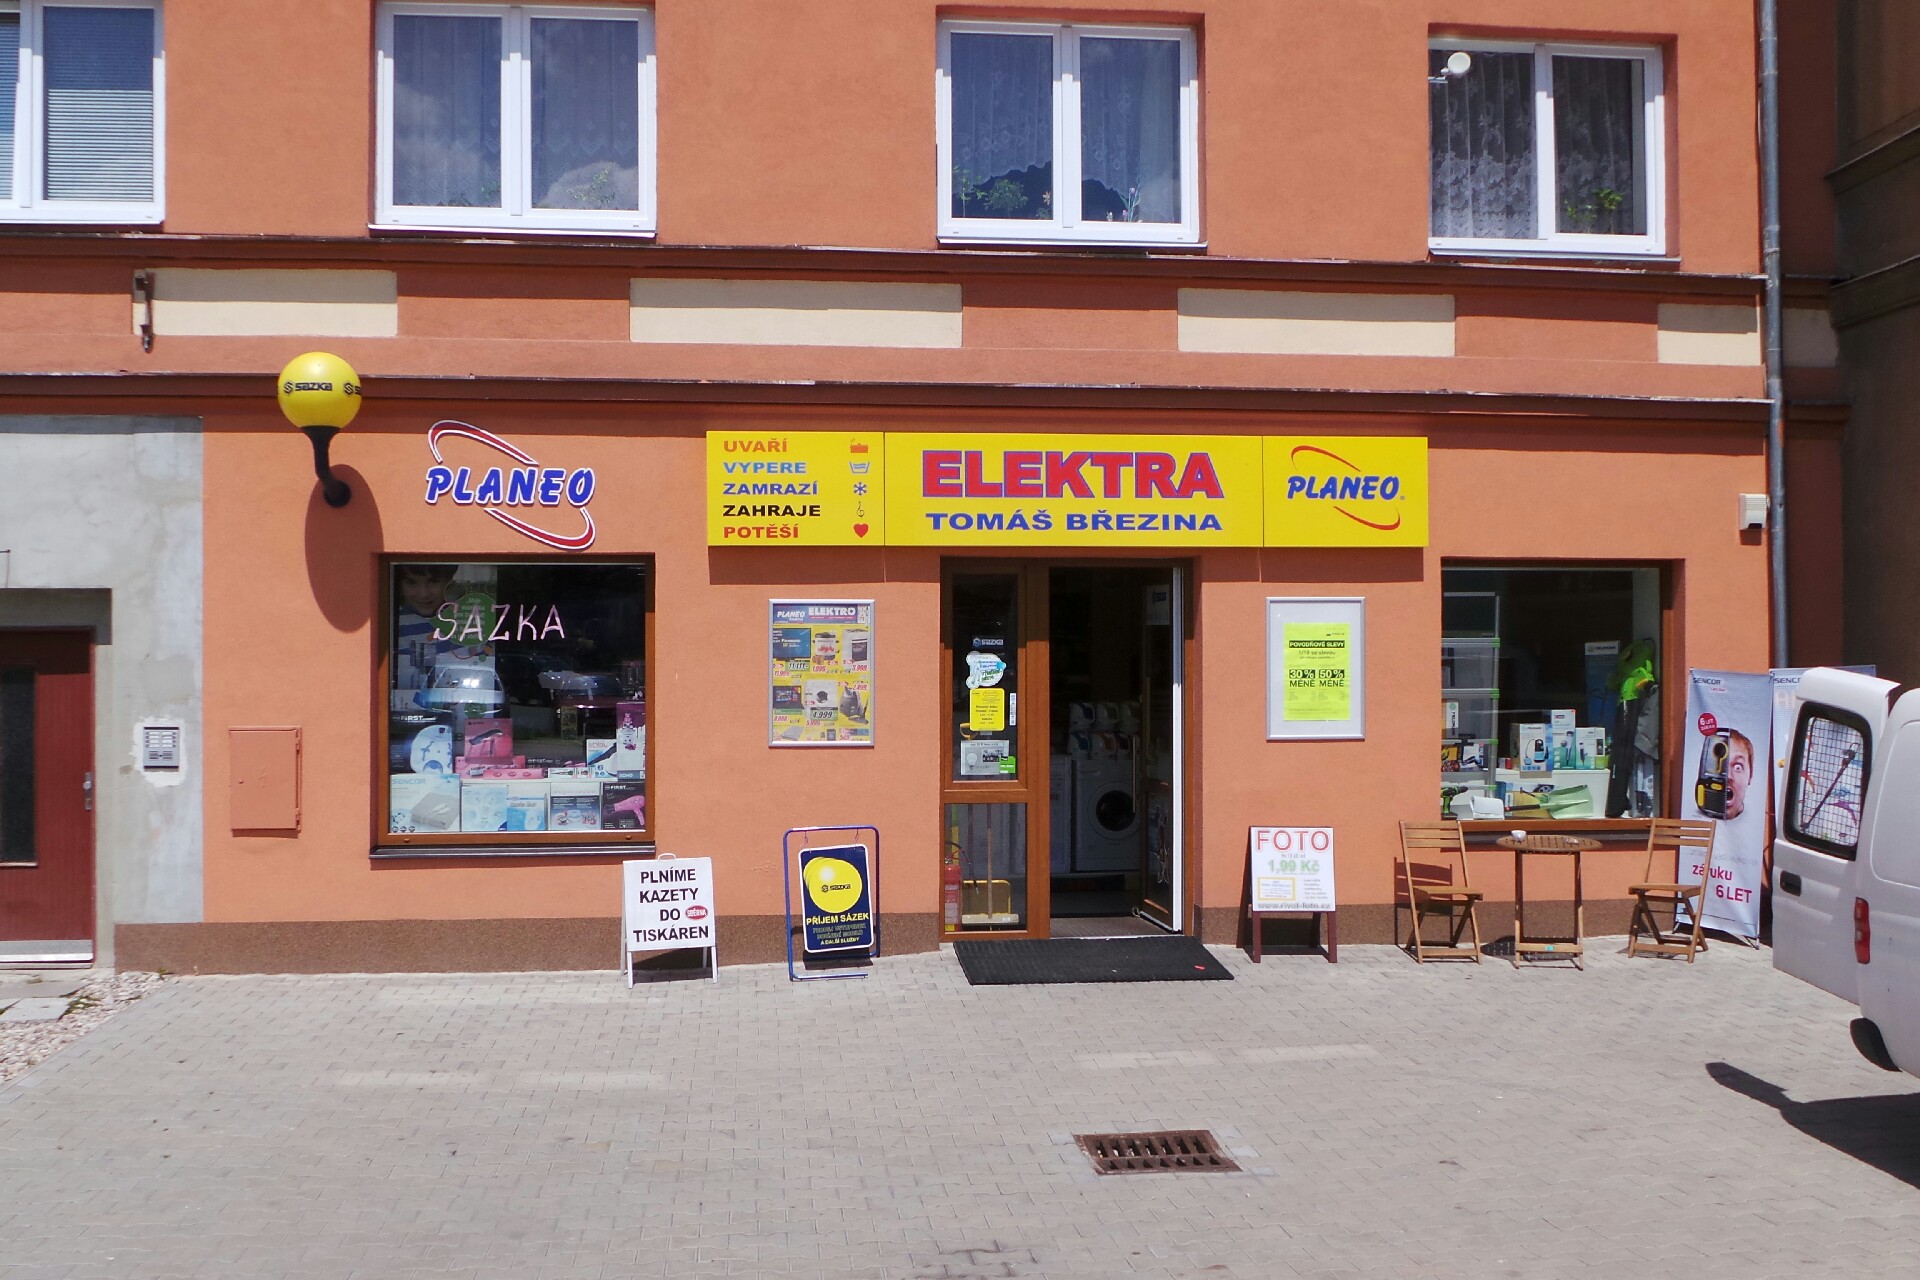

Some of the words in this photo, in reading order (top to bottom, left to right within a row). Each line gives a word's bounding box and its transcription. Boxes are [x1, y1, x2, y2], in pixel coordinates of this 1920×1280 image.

[723, 438, 788, 453] UVAŘÍ
[723, 462, 807, 474] VYPERE
[922, 450, 1225, 498] ELEKTRA
[425, 466, 596, 506] PLANEO
[722, 480, 819, 496] ZAMRAZÍ
[1287, 475, 1399, 500] PLANEO
[722, 504, 821, 517] ZAHRAJE
[925, 509, 1053, 531] TOMÁŠ
[1066, 509, 1223, 531] BŘEZINA
[723, 524, 799, 539] POTĚŠÍ
[808, 606, 856, 616] ELEKTRO
[433, 601, 565, 642] SAZKA
[1692, 677, 1721, 685] SENCOR
[1699, 717, 1706, 726] 6
[1257, 830, 1330, 851] FOTO
[1268, 859, 1297, 874] 1,99
[1301, 859, 1320, 872] Kč
[1692, 863, 1733, 881] záuku
[640, 866, 696, 884] PLNÍME
[639, 887, 699, 904] KAZETY
[1715, 884, 1724, 899] 6
[1726, 886, 1752, 904] LET
[659, 908, 681, 922] DO
[806, 914, 839, 926] PŘÍJEM
[840, 912, 870, 923] SÁZEK
[632, 924, 709, 943] TISKÁREN
